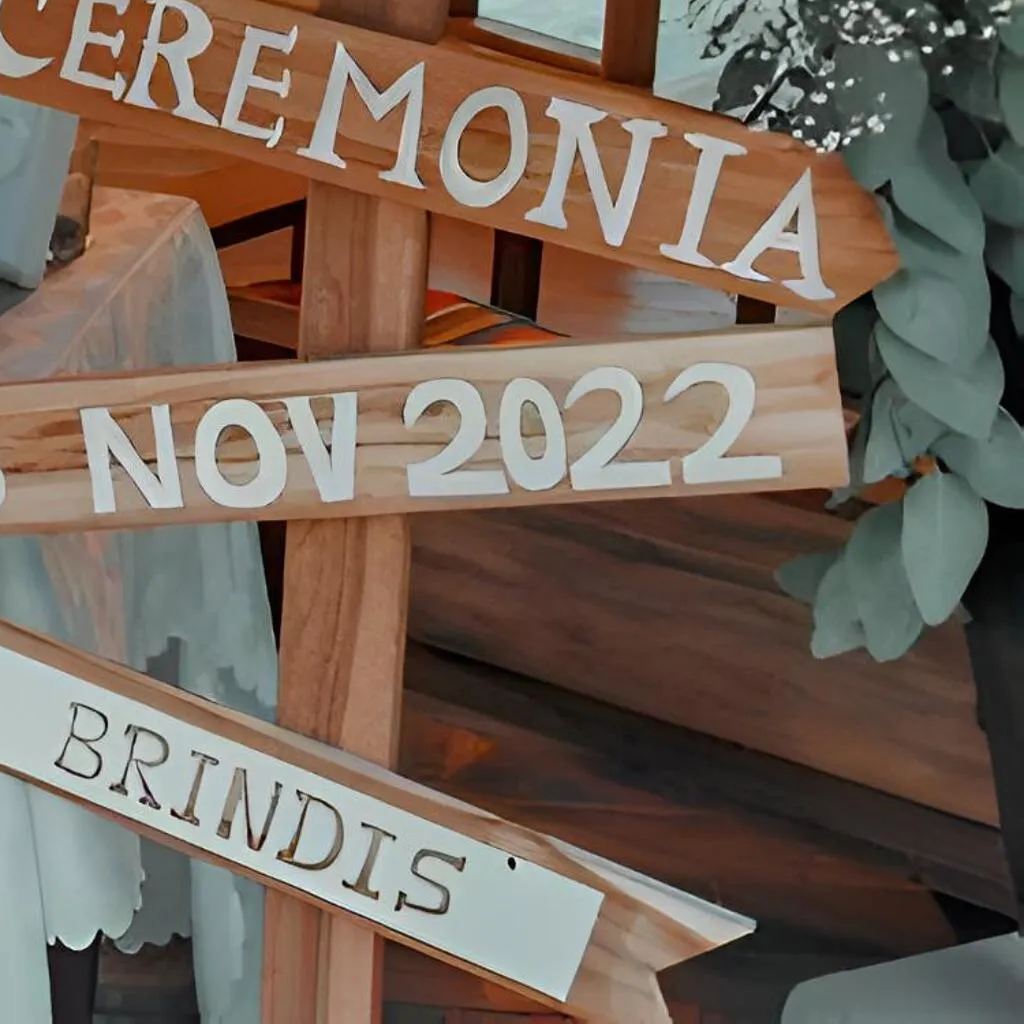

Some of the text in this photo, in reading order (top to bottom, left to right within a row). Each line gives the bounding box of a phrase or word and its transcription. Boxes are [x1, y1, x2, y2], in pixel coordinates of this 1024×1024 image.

[80, 391, 358, 514] NOV
[402, 362, 783, 499] 2022
[54, 700, 467, 916] BRINDIS
